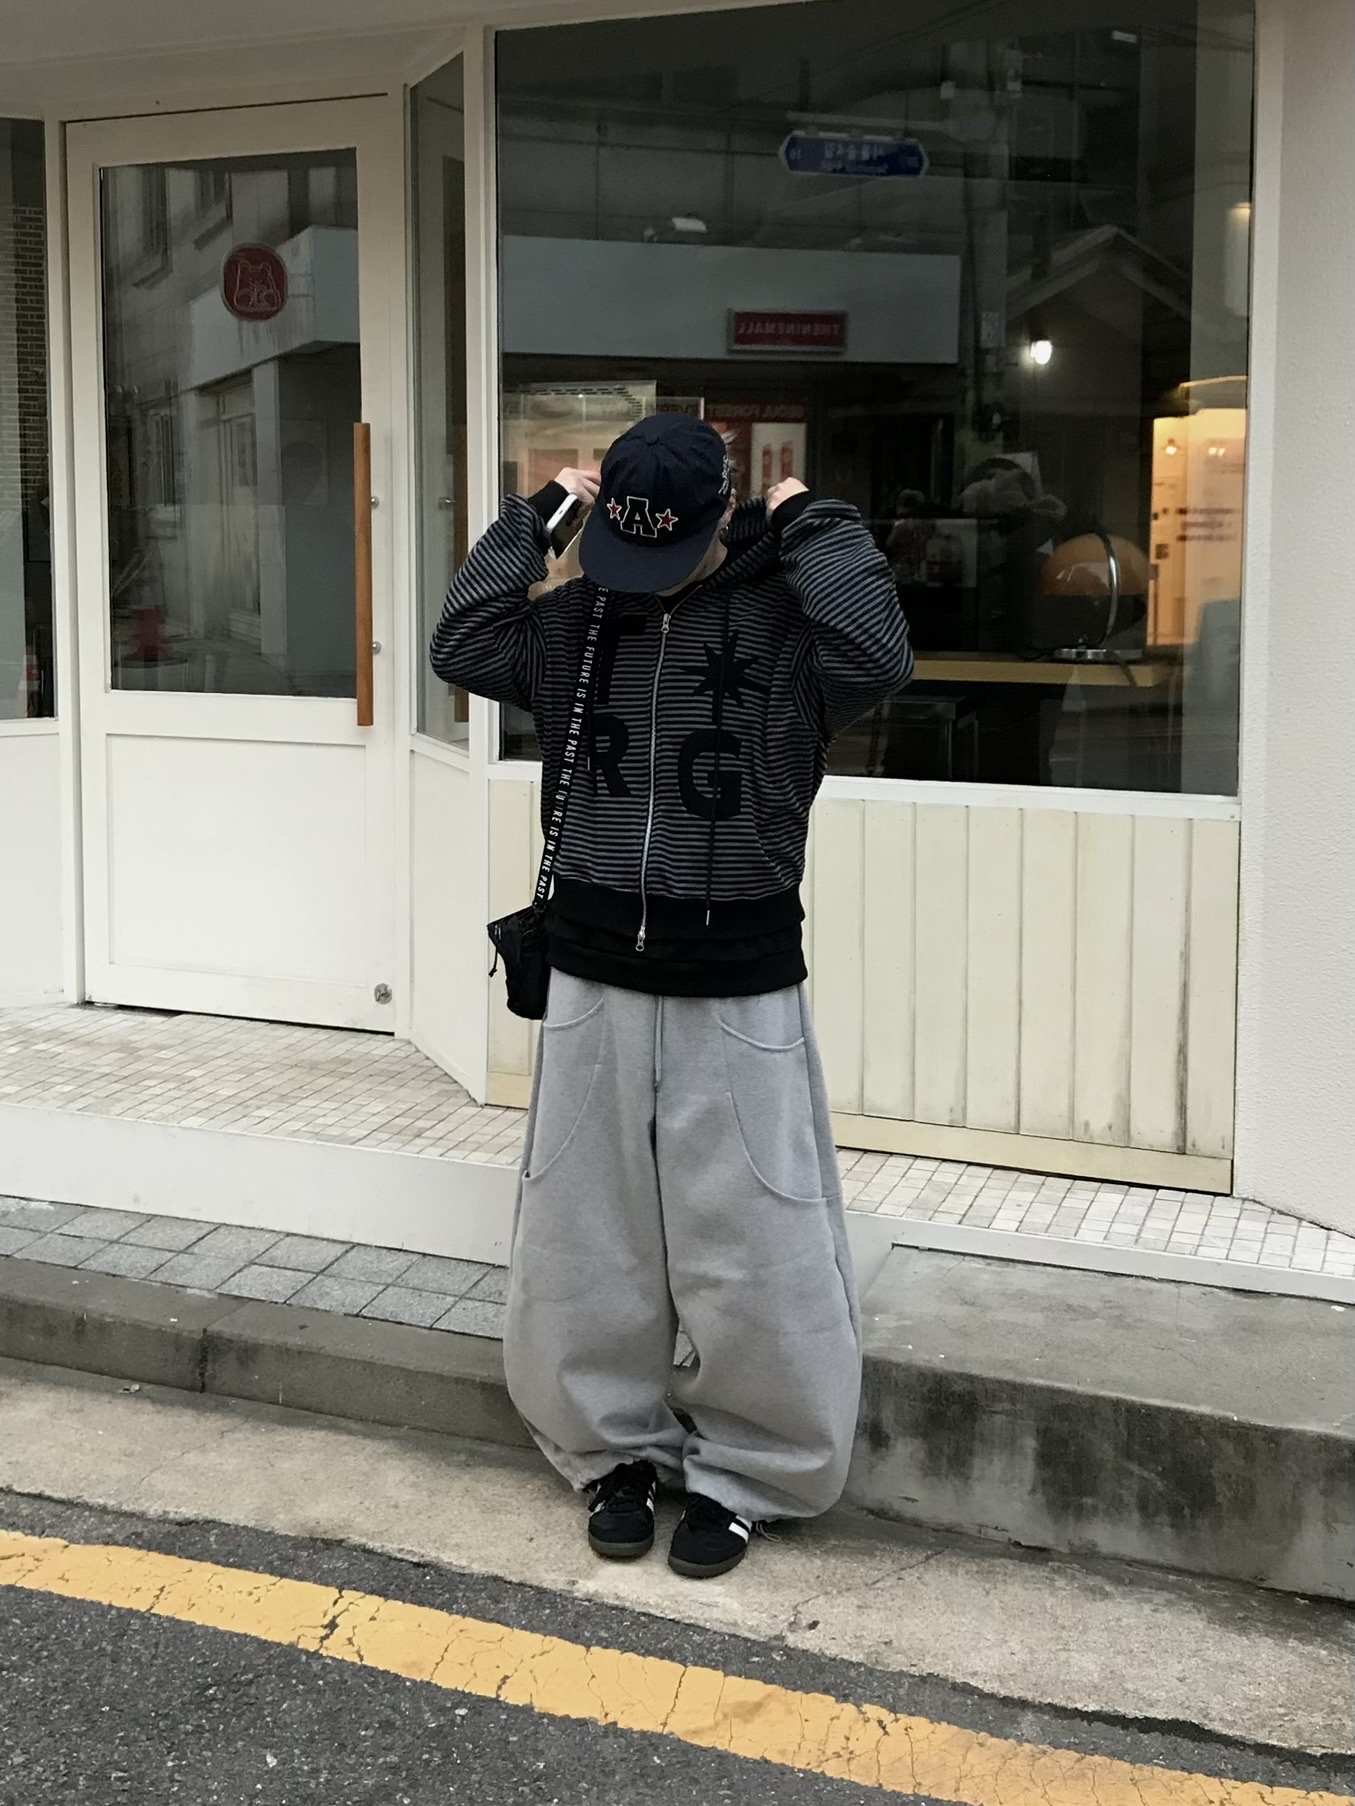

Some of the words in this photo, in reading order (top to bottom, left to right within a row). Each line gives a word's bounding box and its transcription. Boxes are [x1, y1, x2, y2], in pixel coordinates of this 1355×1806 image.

[620, 495, 658, 538] A
[592, 595, 607, 619] PAST
[586, 624, 601, 641] THE
[579, 646, 595, 684] FUTURE
[576, 688, 587, 699] IS
[573, 702, 585, 714] IN
[568, 717, 582, 736] THE
[563, 739, 578, 763] PAST
[590, 715, 632, 797] R
[678, 728, 742, 819] G
[559, 768, 573, 786] THE
[549, 826, 559, 837] IS
[546, 839, 556, 852] IN
[541, 854, 553, 873] THE
[536, 874, 548, 899] PAST
